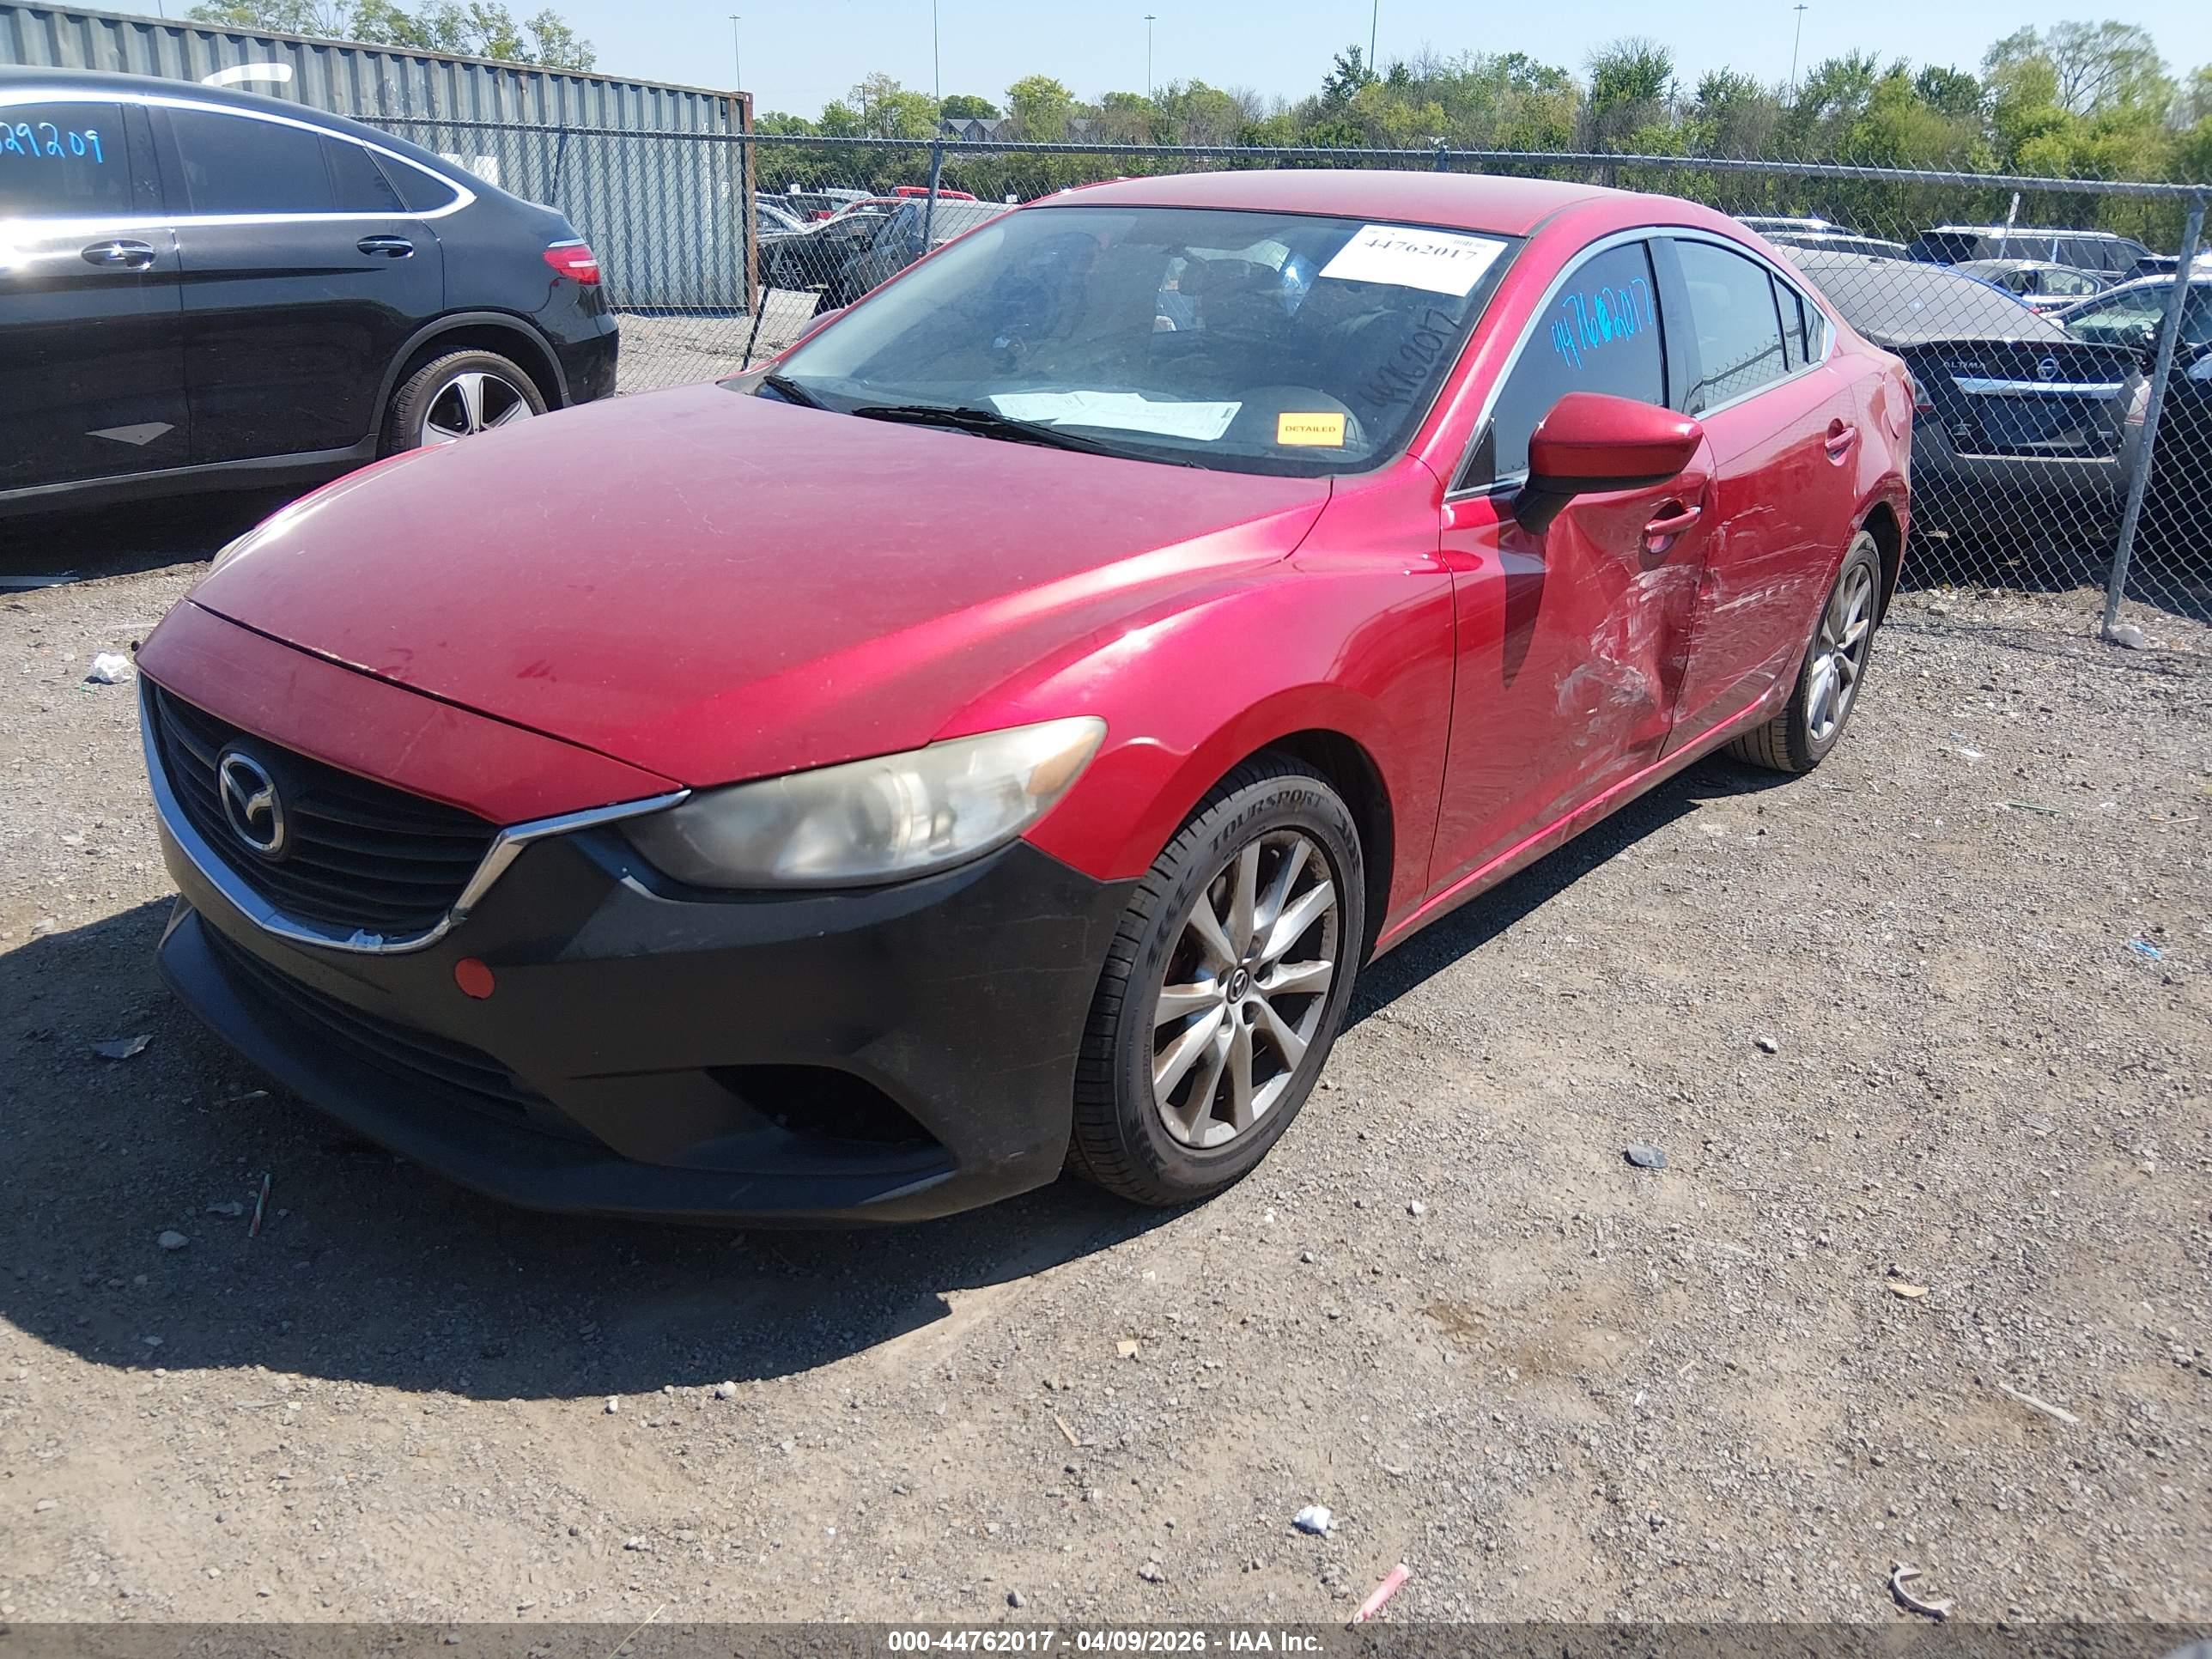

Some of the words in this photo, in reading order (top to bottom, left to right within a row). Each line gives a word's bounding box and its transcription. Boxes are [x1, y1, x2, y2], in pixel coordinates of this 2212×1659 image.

[0, 121, 103, 165] 29209
[1364, 238, 1478, 260] 44762017
[1209, 788, 1325, 854] TOURSPORT
